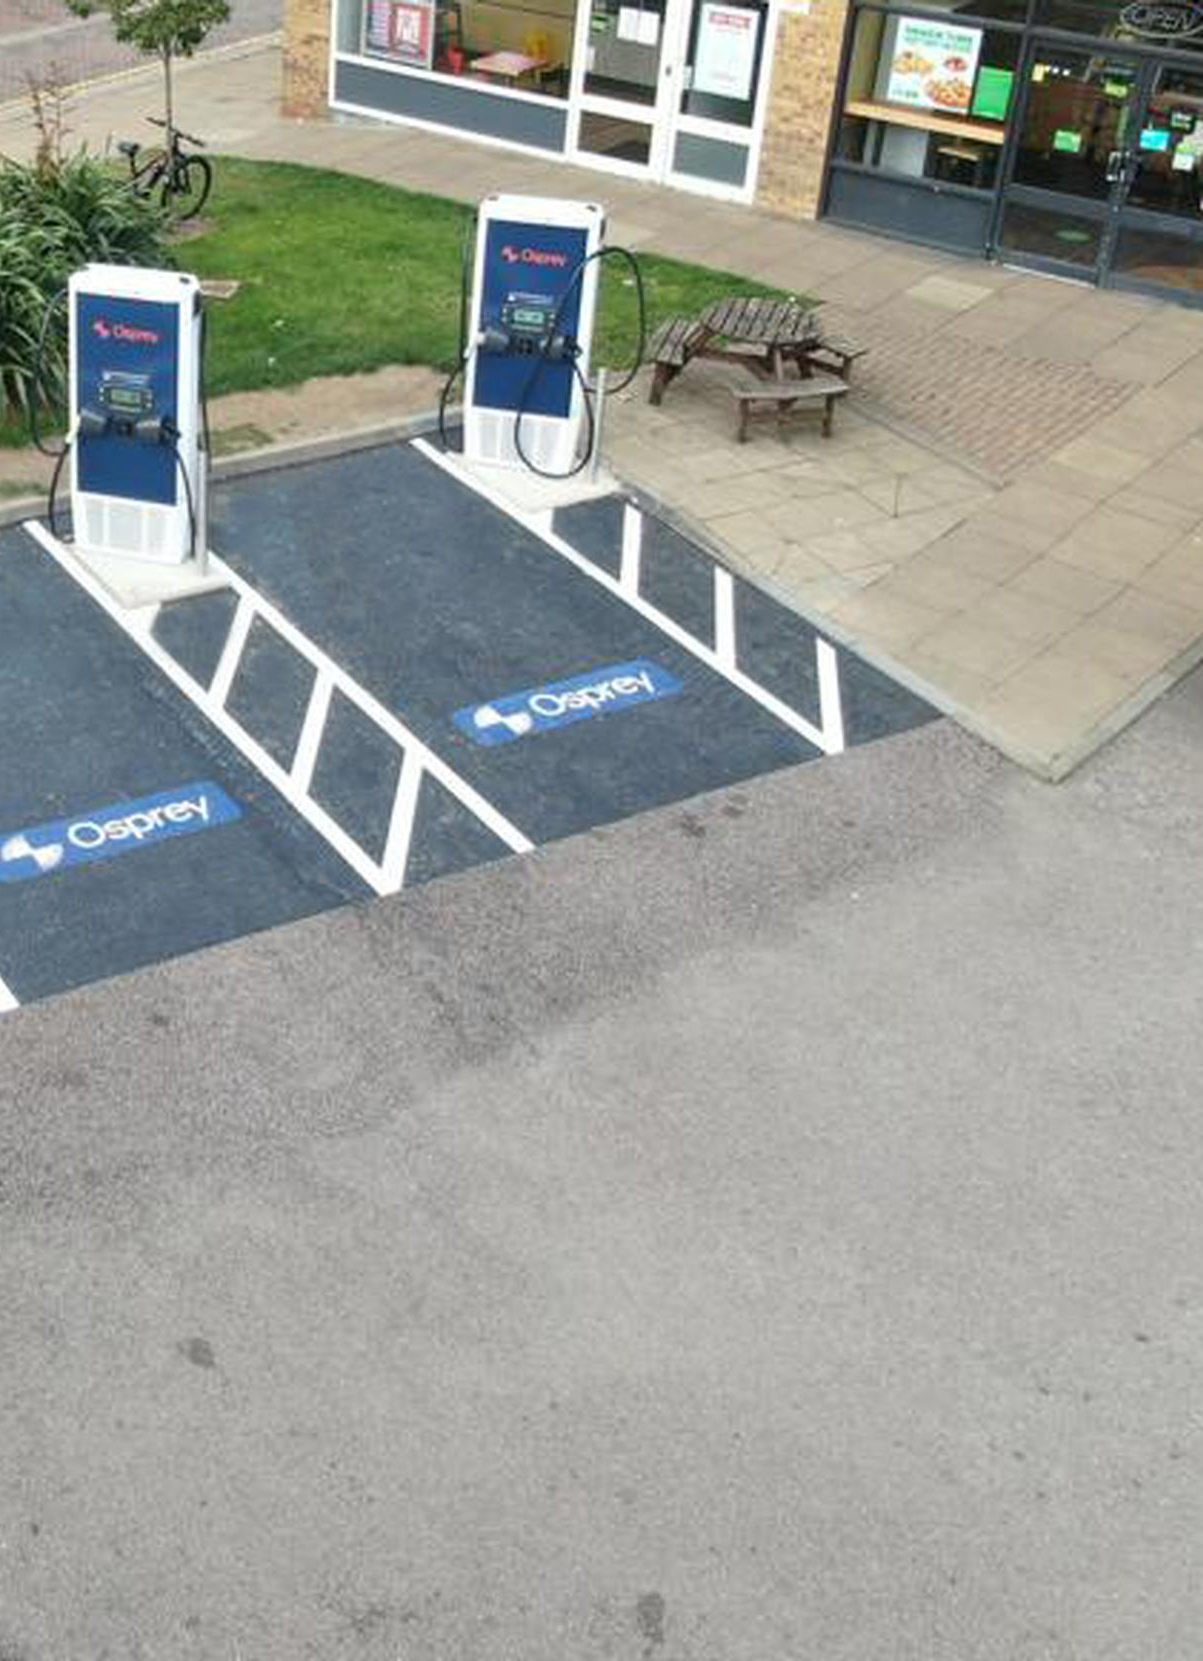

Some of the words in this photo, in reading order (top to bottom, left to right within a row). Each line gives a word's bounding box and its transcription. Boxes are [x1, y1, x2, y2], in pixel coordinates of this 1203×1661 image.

[1131, 7, 1194, 31] OPEN
[522, 248, 566, 268] Osprey
[528, 671, 655, 716] Osprey
[67, 796, 208, 848] Osprey
